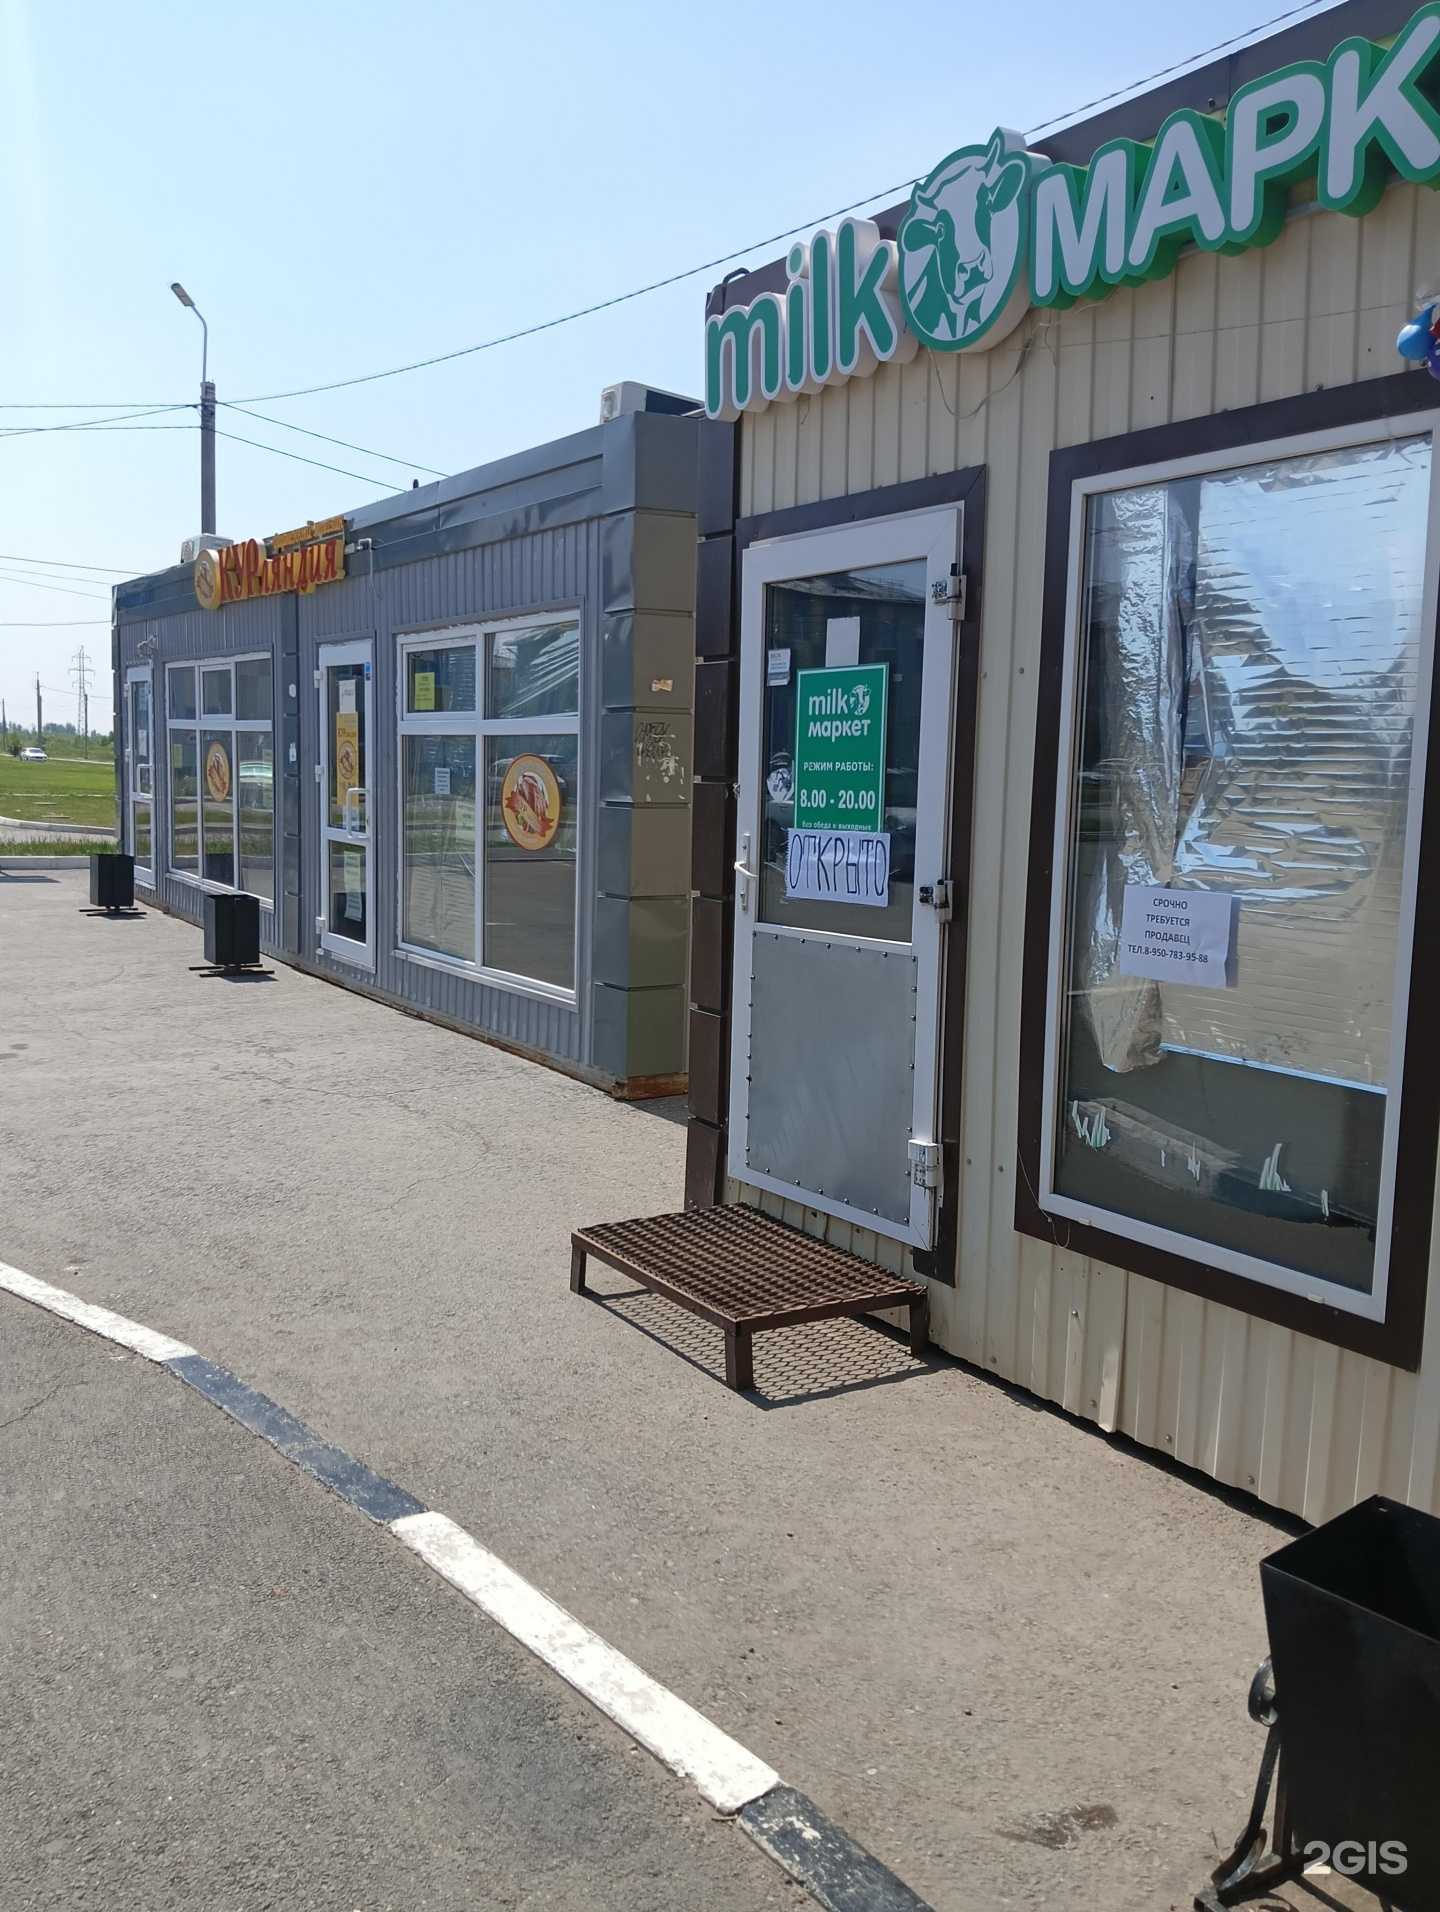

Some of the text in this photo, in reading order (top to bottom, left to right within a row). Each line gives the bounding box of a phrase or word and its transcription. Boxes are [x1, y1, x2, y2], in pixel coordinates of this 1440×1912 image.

[705, 217, 900, 420] milk
[808, 687, 848, 716] milk
[808, 719, 871, 743] маркет
[803, 761, 875, 773] РЕЖИМ РАБОТЫ:
[799, 789, 827, 808] 8.00
[837, 790, 876, 811] 20.00
[838, 823, 872, 832] выходных
[789, 834, 887, 897] ОТКРЫТО
[1152, 898, 1188, 910] СРОЧНО
[1146, 913, 1190, 927] ТРЕБУЕТСЯ
[1144, 930, 1191, 945] ПРОДАВЕЦ
